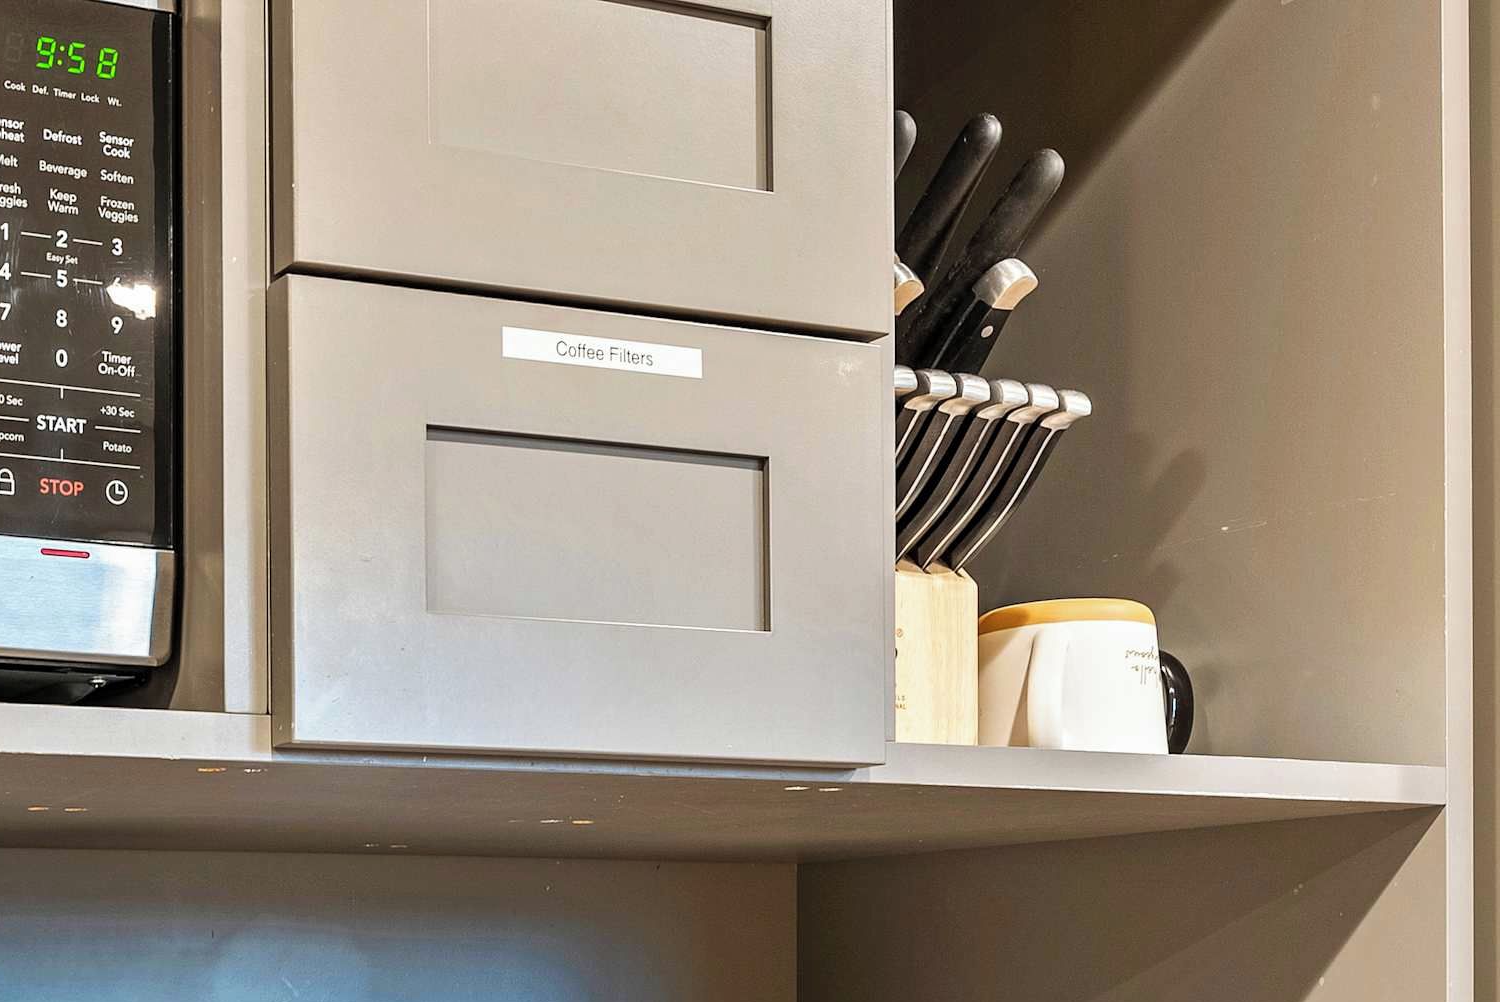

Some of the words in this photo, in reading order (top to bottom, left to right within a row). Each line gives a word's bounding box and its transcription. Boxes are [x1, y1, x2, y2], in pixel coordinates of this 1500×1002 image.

[35, 36, 119, 80] 9:58
[3, 80, 26, 92] Cook
[32, 85, 49, 95] Def.
[53, 88, 77, 99] Timer
[81, 92, 100, 103] Lock
[107, 97, 122, 107] Wt.
[43, 129, 83, 146] Defrost
[99, 131, 134, 148] Sensor
[103, 145, 131, 159] Cook
[39, 160, 88, 179] Beverage
[100, 169, 134, 184] Soften
[49, 188, 77, 204] Keep
[100, 196, 135, 210] Frozen
[47, 200, 79, 215] Warm
[98, 207, 139, 224] Veggies
[0, 223, 9, 241] 1
[56, 230, 68, 248] 2
[111, 238, 123, 256] 3
[46, 252, 65, 265] Easy
[65, 253, 78, 265] Set
[0, 263, 12, 280] 4
[56, 270, 68, 288] 5
[0, 303, 12, 320] 7
[56, 309, 68, 327] 8
[111, 316, 123, 334] 9
[55, 349, 68, 367] 0
[101, 350, 132, 365] Timer
[555, 340, 604, 361] Coffee
[609, 346, 654, 367] Filters
[98, 363, 136, 378] On-Off
[6, 396, 23, 407] Sec
[100, 405, 117, 416] +30
[118, 408, 135, 419] Sec
[36, 415, 87, 434] START
[103, 441, 132, 454] Potato
[39, 478, 84, 496] STOP
